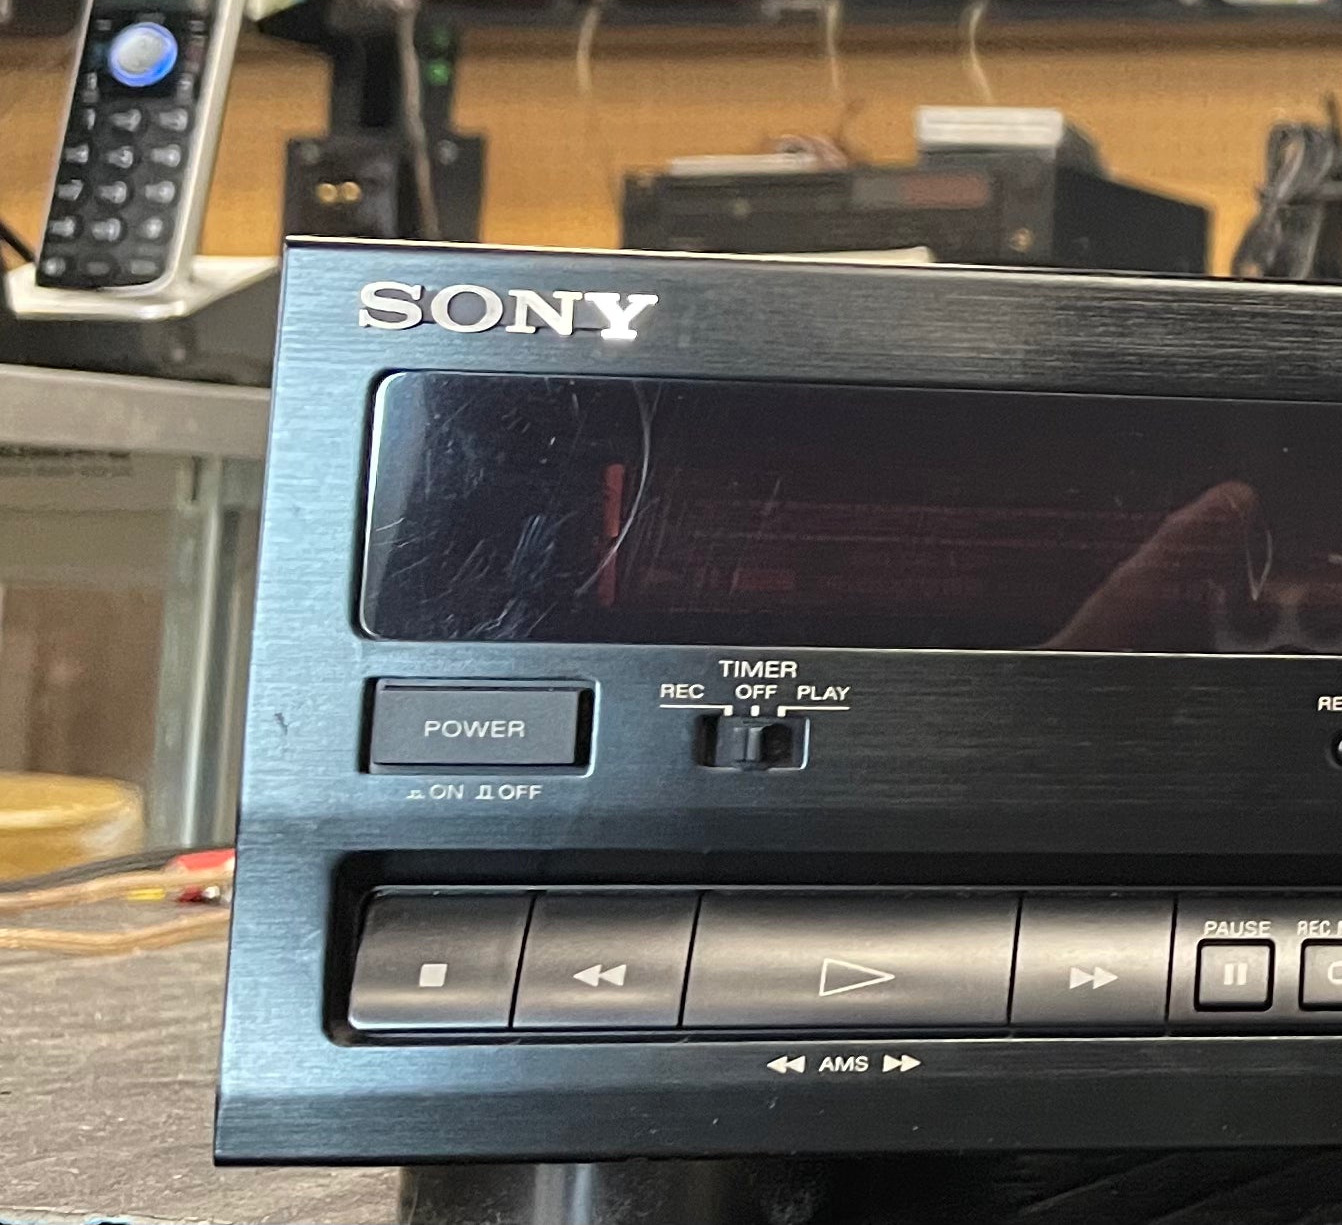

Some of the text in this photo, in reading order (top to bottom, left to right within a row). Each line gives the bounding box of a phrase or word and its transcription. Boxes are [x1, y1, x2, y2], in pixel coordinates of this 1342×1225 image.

[358, 280, 659, 340] SONY
[718, 659, 798, 679] TIMER
[659, 683, 705, 699] REC
[735, 683, 778, 700] OFF
[796, 685, 851, 701] PLAY
[424, 720, 525, 738] POWER
[428, 783, 542, 800] ON OFF
[1201, 918, 1274, 940] PAUSE
[1296, 919, 1332, 938] REC
[818, 1055, 869, 1072] AMS
